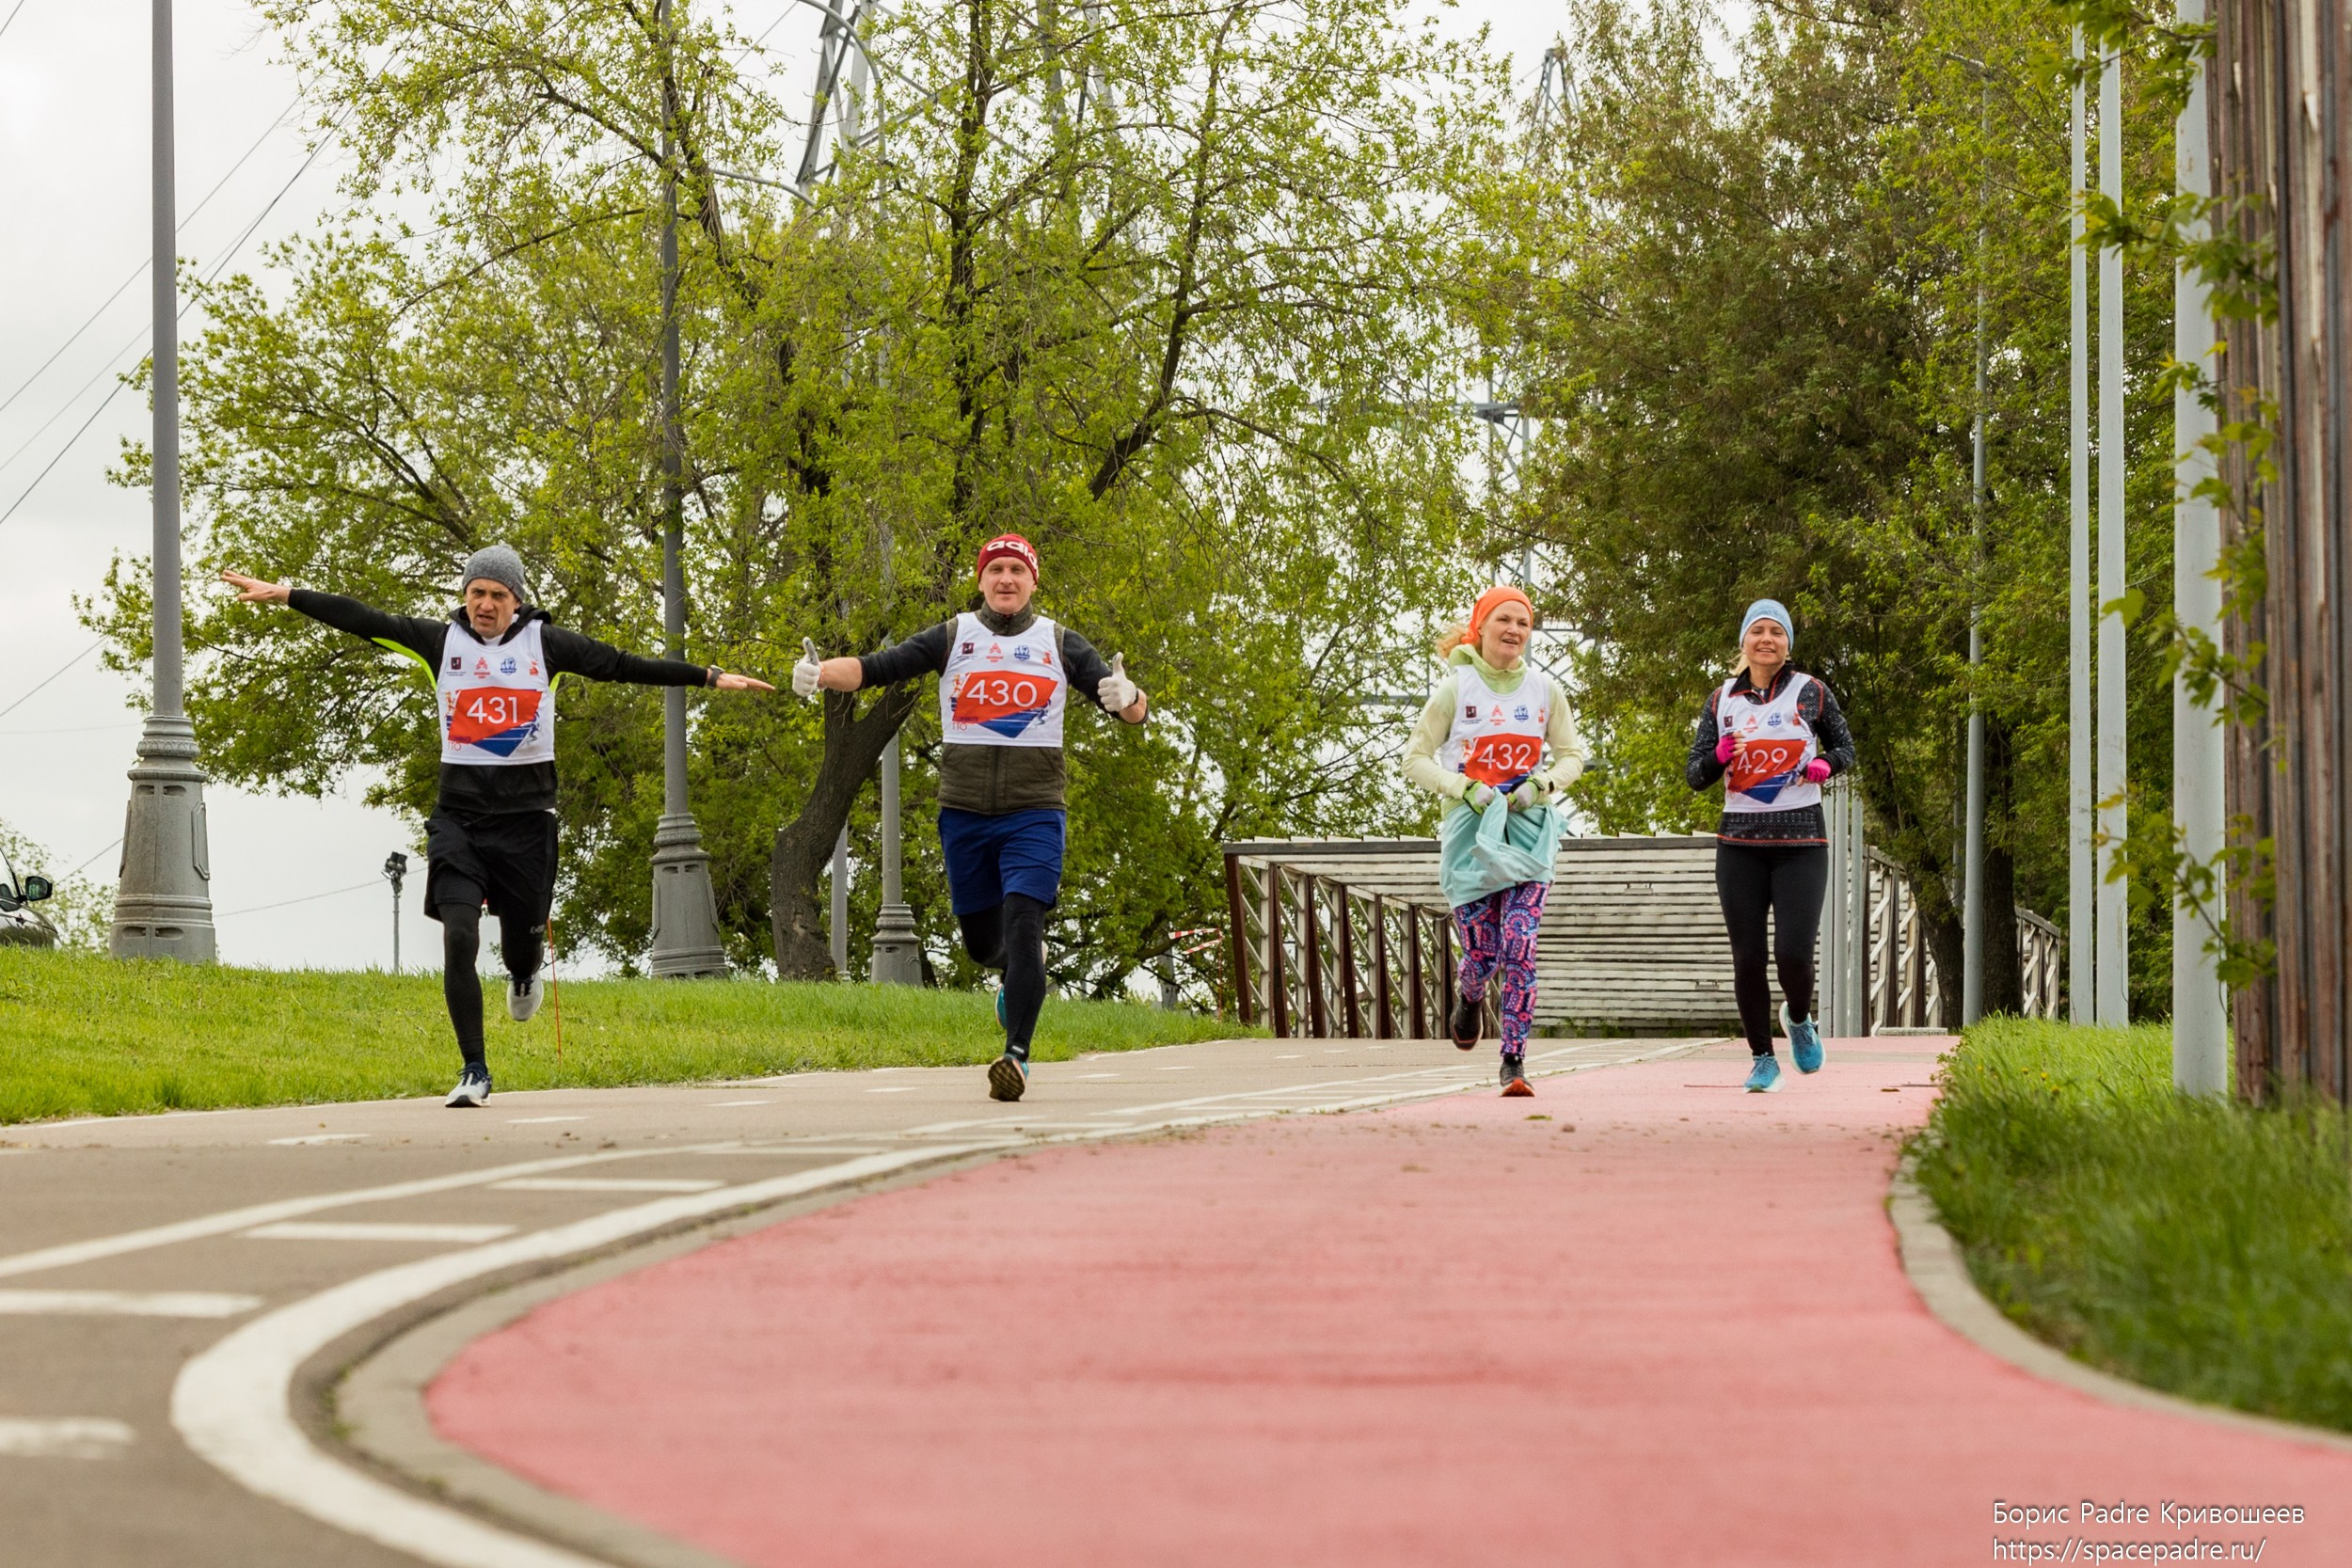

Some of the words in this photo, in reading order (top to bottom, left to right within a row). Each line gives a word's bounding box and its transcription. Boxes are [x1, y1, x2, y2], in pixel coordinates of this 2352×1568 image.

[966, 679, 1038, 707] 430
[466, 696, 518, 724] 431
[1477, 743, 1532, 770] 432
[1737, 747, 1788, 774] 429
